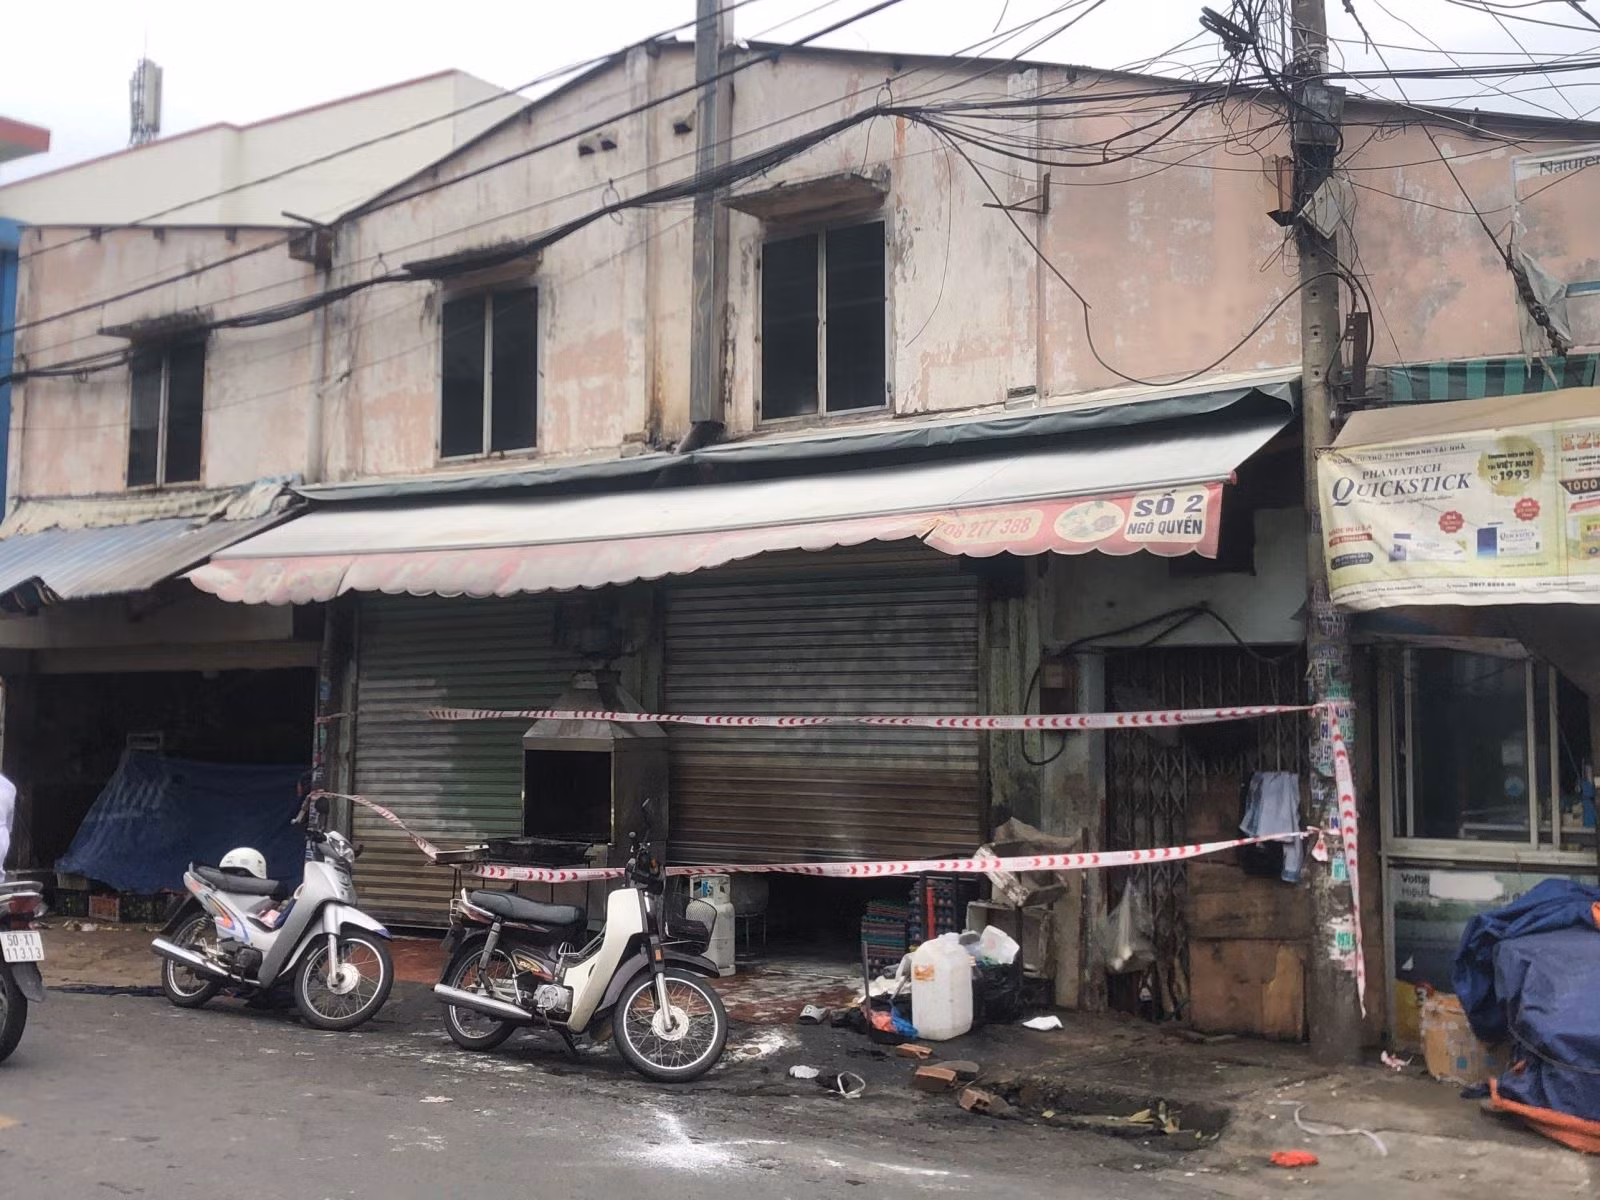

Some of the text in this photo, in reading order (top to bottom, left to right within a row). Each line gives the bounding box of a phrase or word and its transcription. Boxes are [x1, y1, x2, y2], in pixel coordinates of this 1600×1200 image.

[1362, 463, 1442, 480] PHAMATECH
[1516, 460, 1533, 468] NAM
[1499, 469, 1530, 480] 1993
[1332, 472, 1473, 507] QUICKSTICK
[1567, 479, 1598, 491] 1000
[1134, 489, 1204, 517] SỐ 2
[1000, 517, 1031, 534] 388
[1127, 519, 1154, 535] NGÔ
